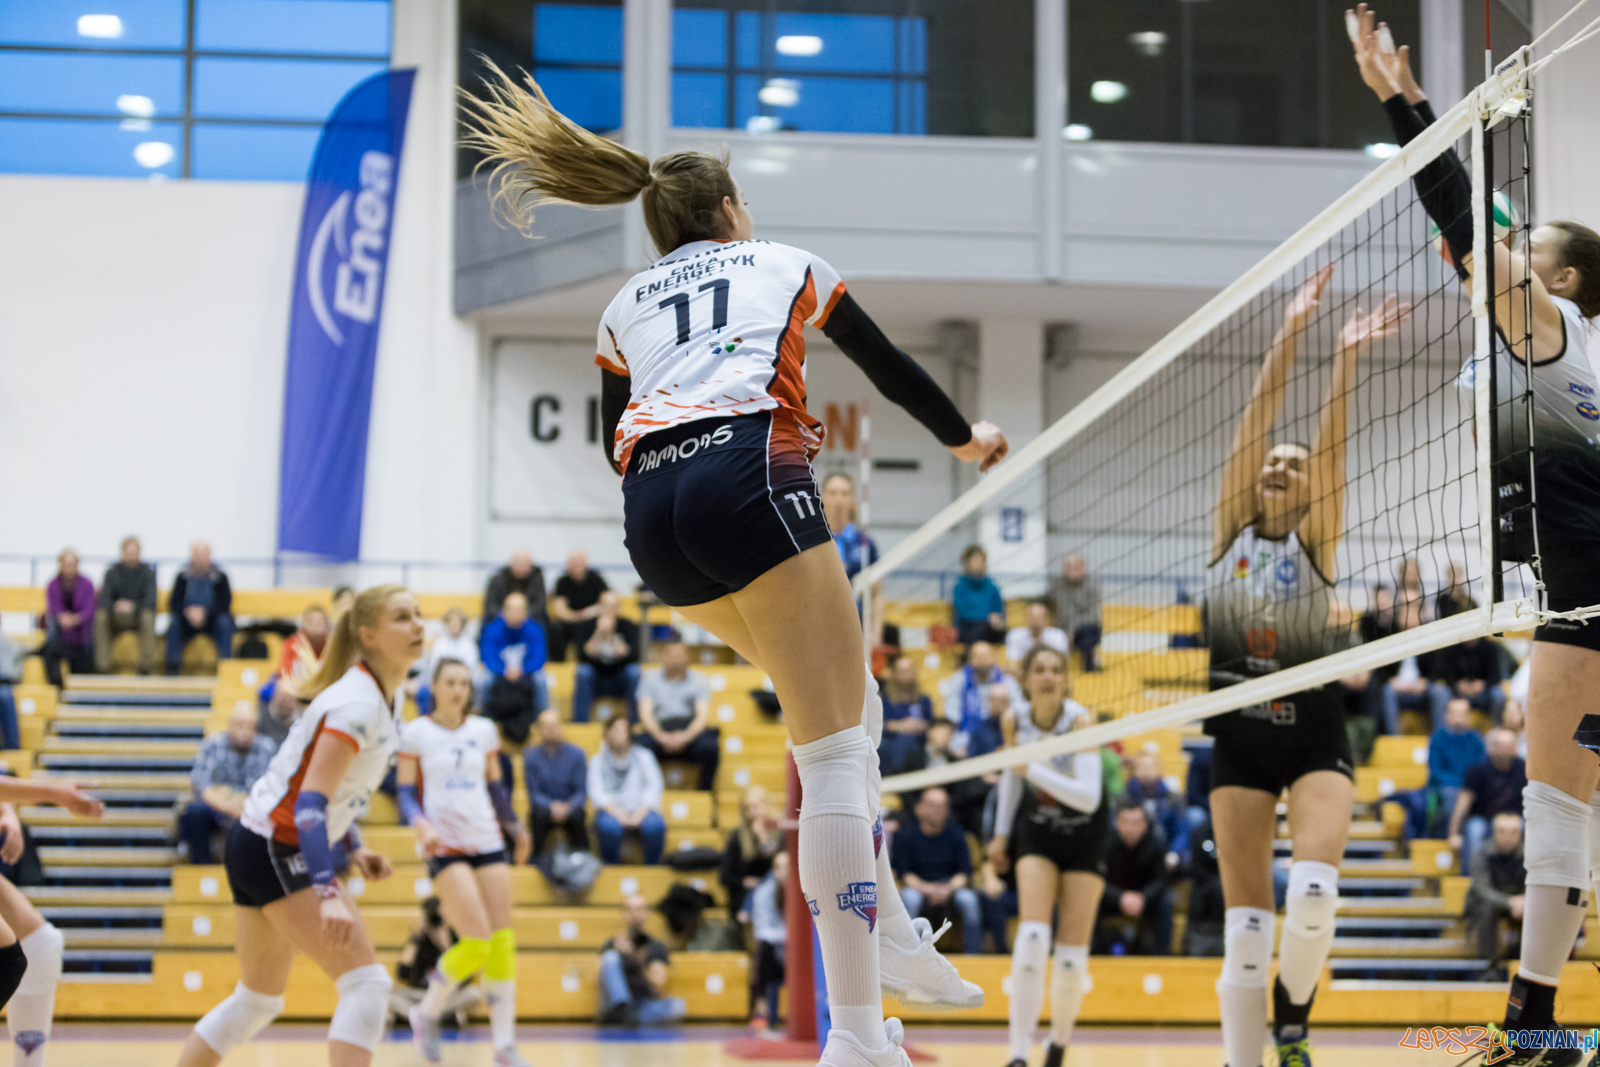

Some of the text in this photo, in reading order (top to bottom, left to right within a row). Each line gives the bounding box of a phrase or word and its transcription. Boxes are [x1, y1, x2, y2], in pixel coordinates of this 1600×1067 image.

[333, 149, 395, 323] Enea
[636, 253, 756, 304] ENERGETYK
[671, 256, 719, 276] ENEA
[658, 278, 730, 346] 11
[784, 490, 816, 520] 11
[839, 892, 877, 907] ENERGE
